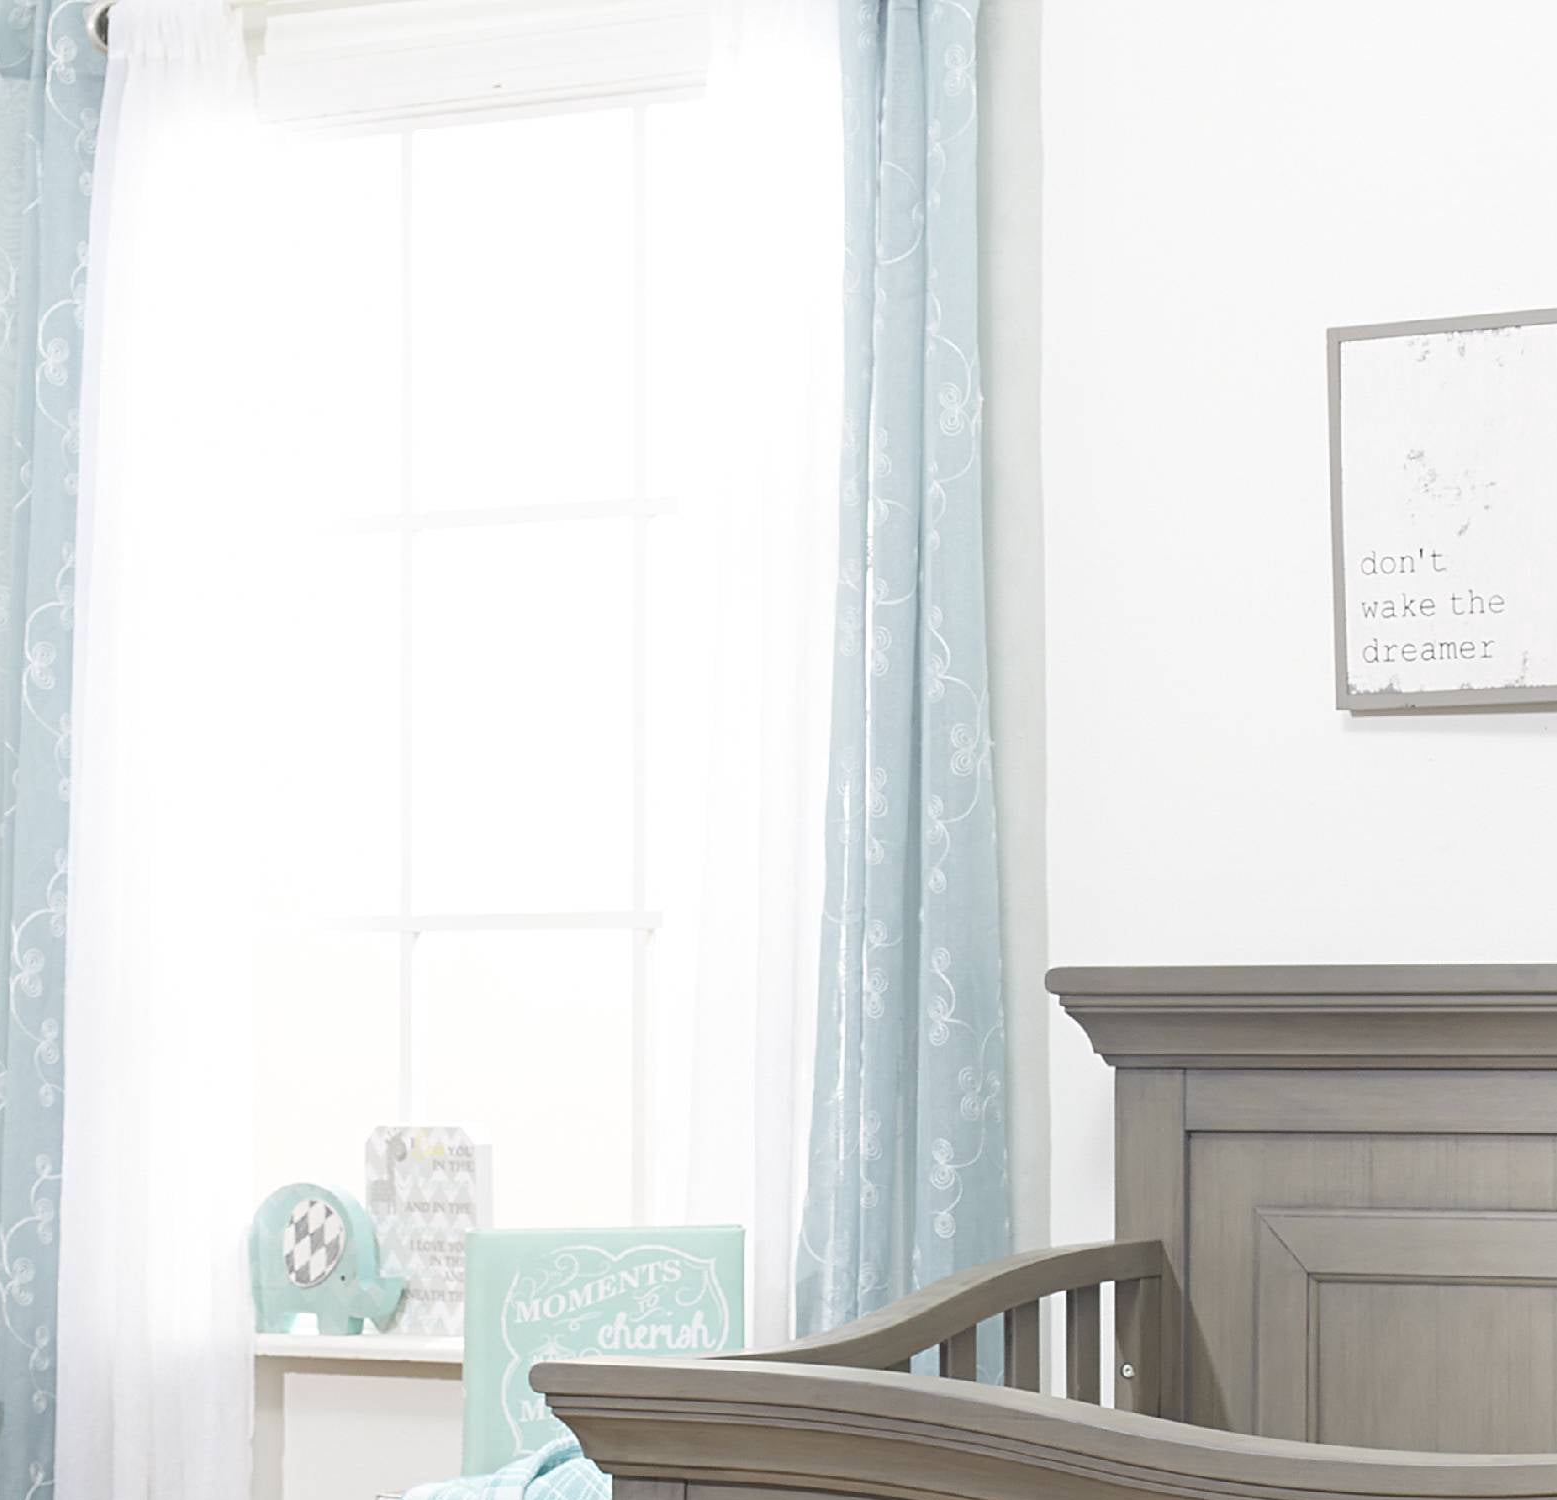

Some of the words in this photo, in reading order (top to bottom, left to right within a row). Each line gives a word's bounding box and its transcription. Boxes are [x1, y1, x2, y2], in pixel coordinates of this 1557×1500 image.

[1360, 548, 1447, 576] don't
[1361, 592, 1437, 619] wake
[1451, 589, 1507, 615] the
[1362, 637, 1496, 664] dreamer
[432, 1160, 445, 1171] IN
[448, 1160, 475, 1172] THE
[405, 1202, 430, 1213] AND
[432, 1202, 445, 1213] IN
[447, 1203, 472, 1215] THE
[447, 1242, 464, 1253] YO
[514, 1259, 682, 1323] MOMENTS
[597, 1310, 717, 1350] cherish
